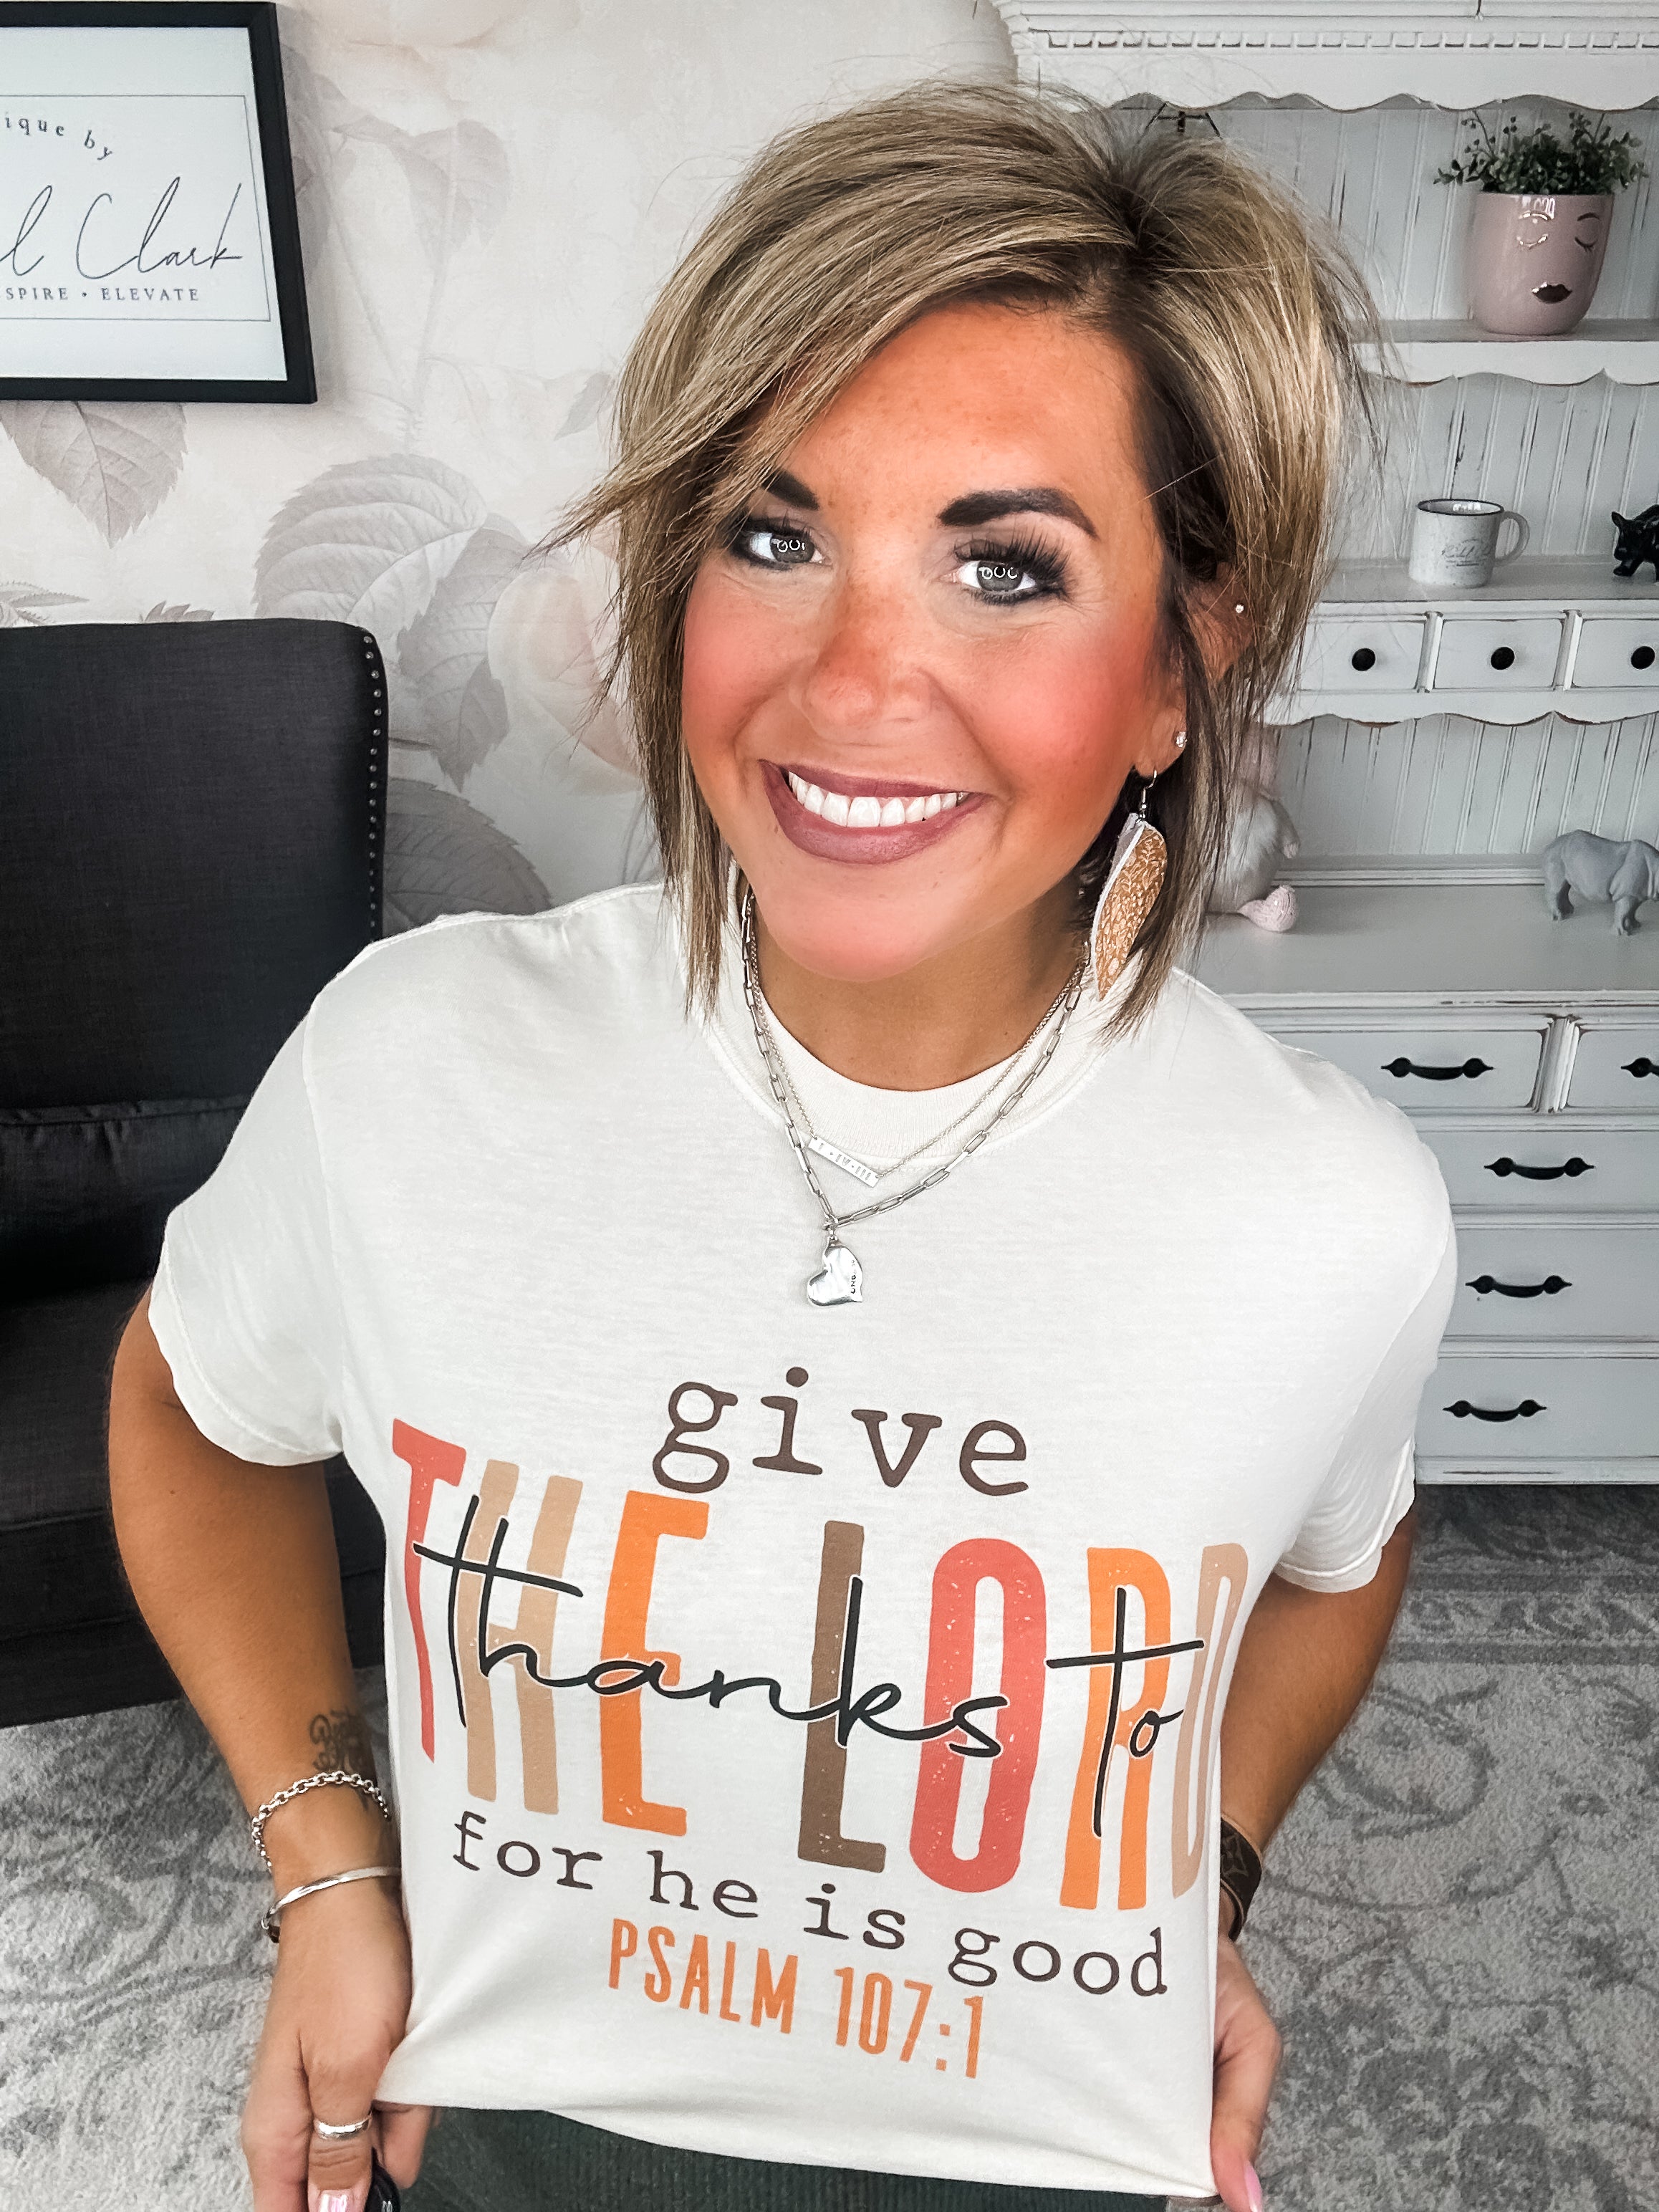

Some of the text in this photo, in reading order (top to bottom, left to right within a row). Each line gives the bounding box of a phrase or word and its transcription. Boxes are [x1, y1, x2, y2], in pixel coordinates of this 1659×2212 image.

[84, 130, 112, 160] by
[76, 176, 243, 279] Clark
[101, 287, 199, 301] ELEVATE
[651, 1367, 1028, 1496] give
[393, 1418, 1248, 1911] THE LORD
[413, 1494, 1205, 1837] thanks to
[453, 1811, 1168, 1997] for he is good
[608, 1918, 984, 2079] PSALM 107:1
